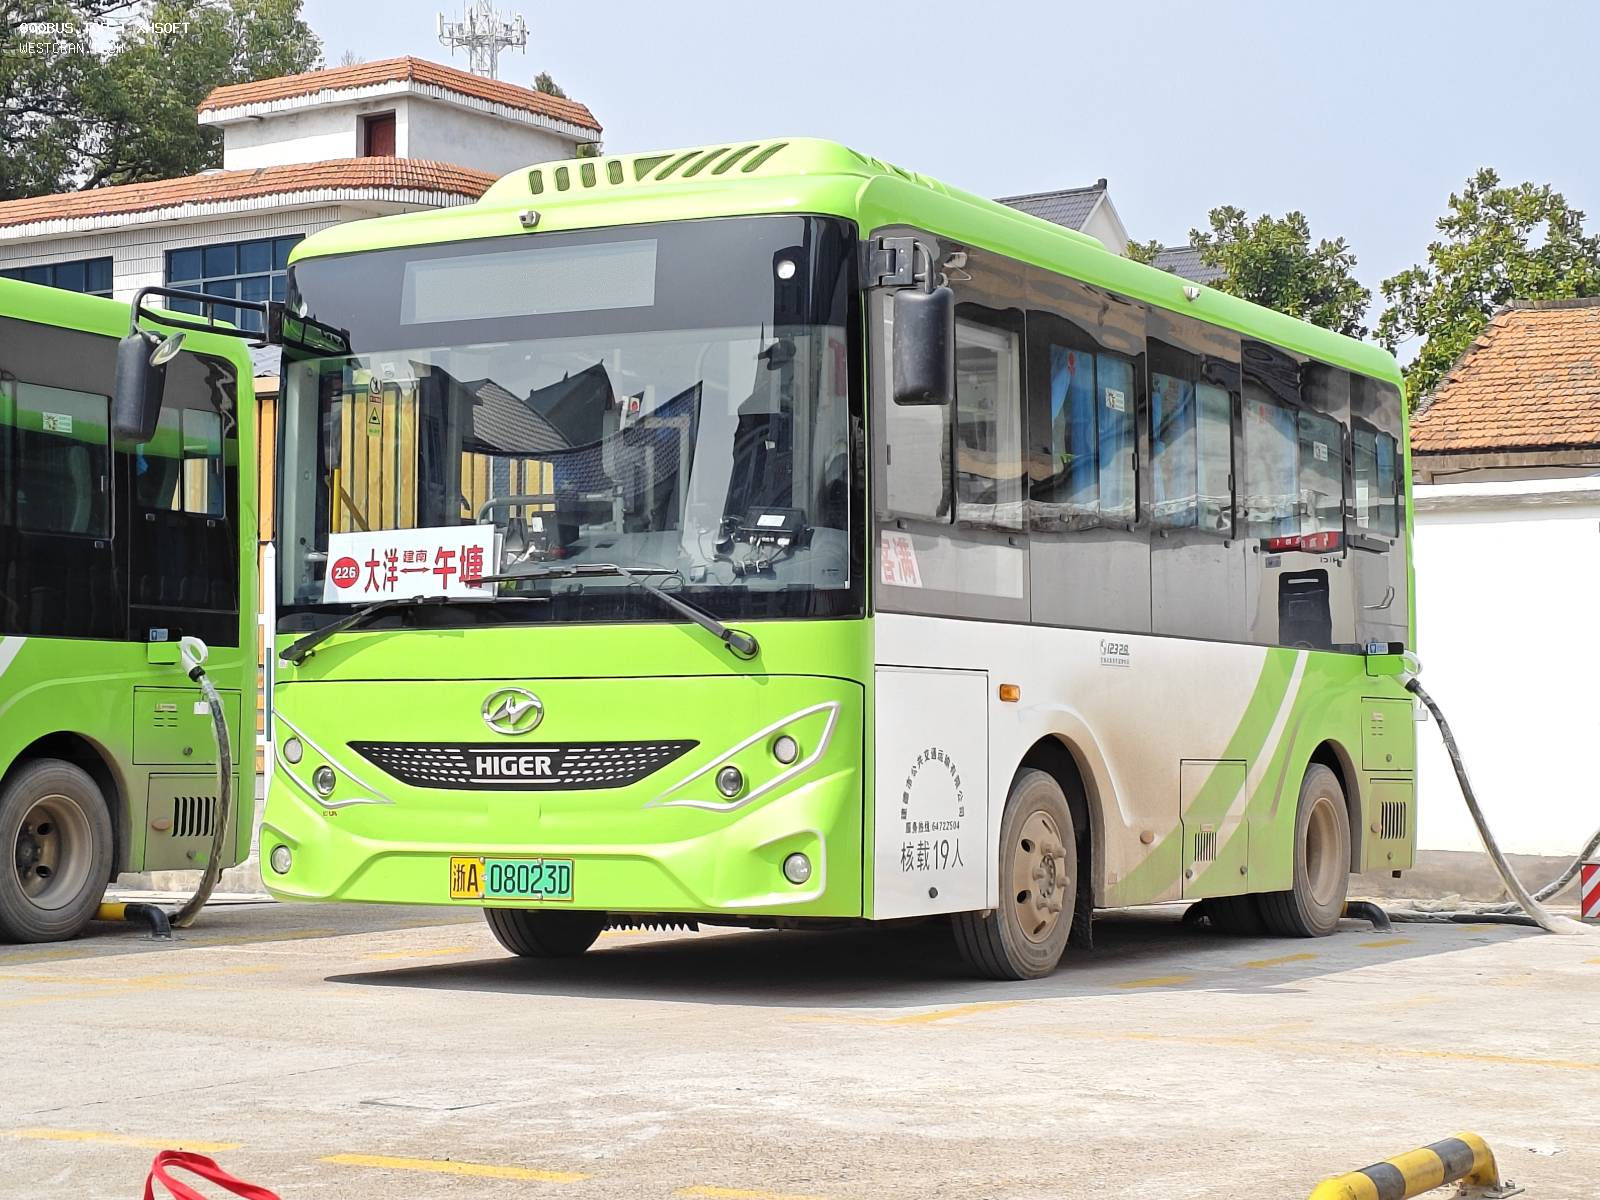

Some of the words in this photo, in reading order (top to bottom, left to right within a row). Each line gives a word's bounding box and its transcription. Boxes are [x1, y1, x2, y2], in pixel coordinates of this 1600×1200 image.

[334, 566, 357, 580] 226
[364, 547, 399, 593] 大洋
[432, 544, 485, 591] 午塘
[402, 550, 428, 564] 建南
[475, 756, 553, 776] HIGER
[452, 863, 479, 893] 浙A
[489, 864, 571, 895] 08023D
